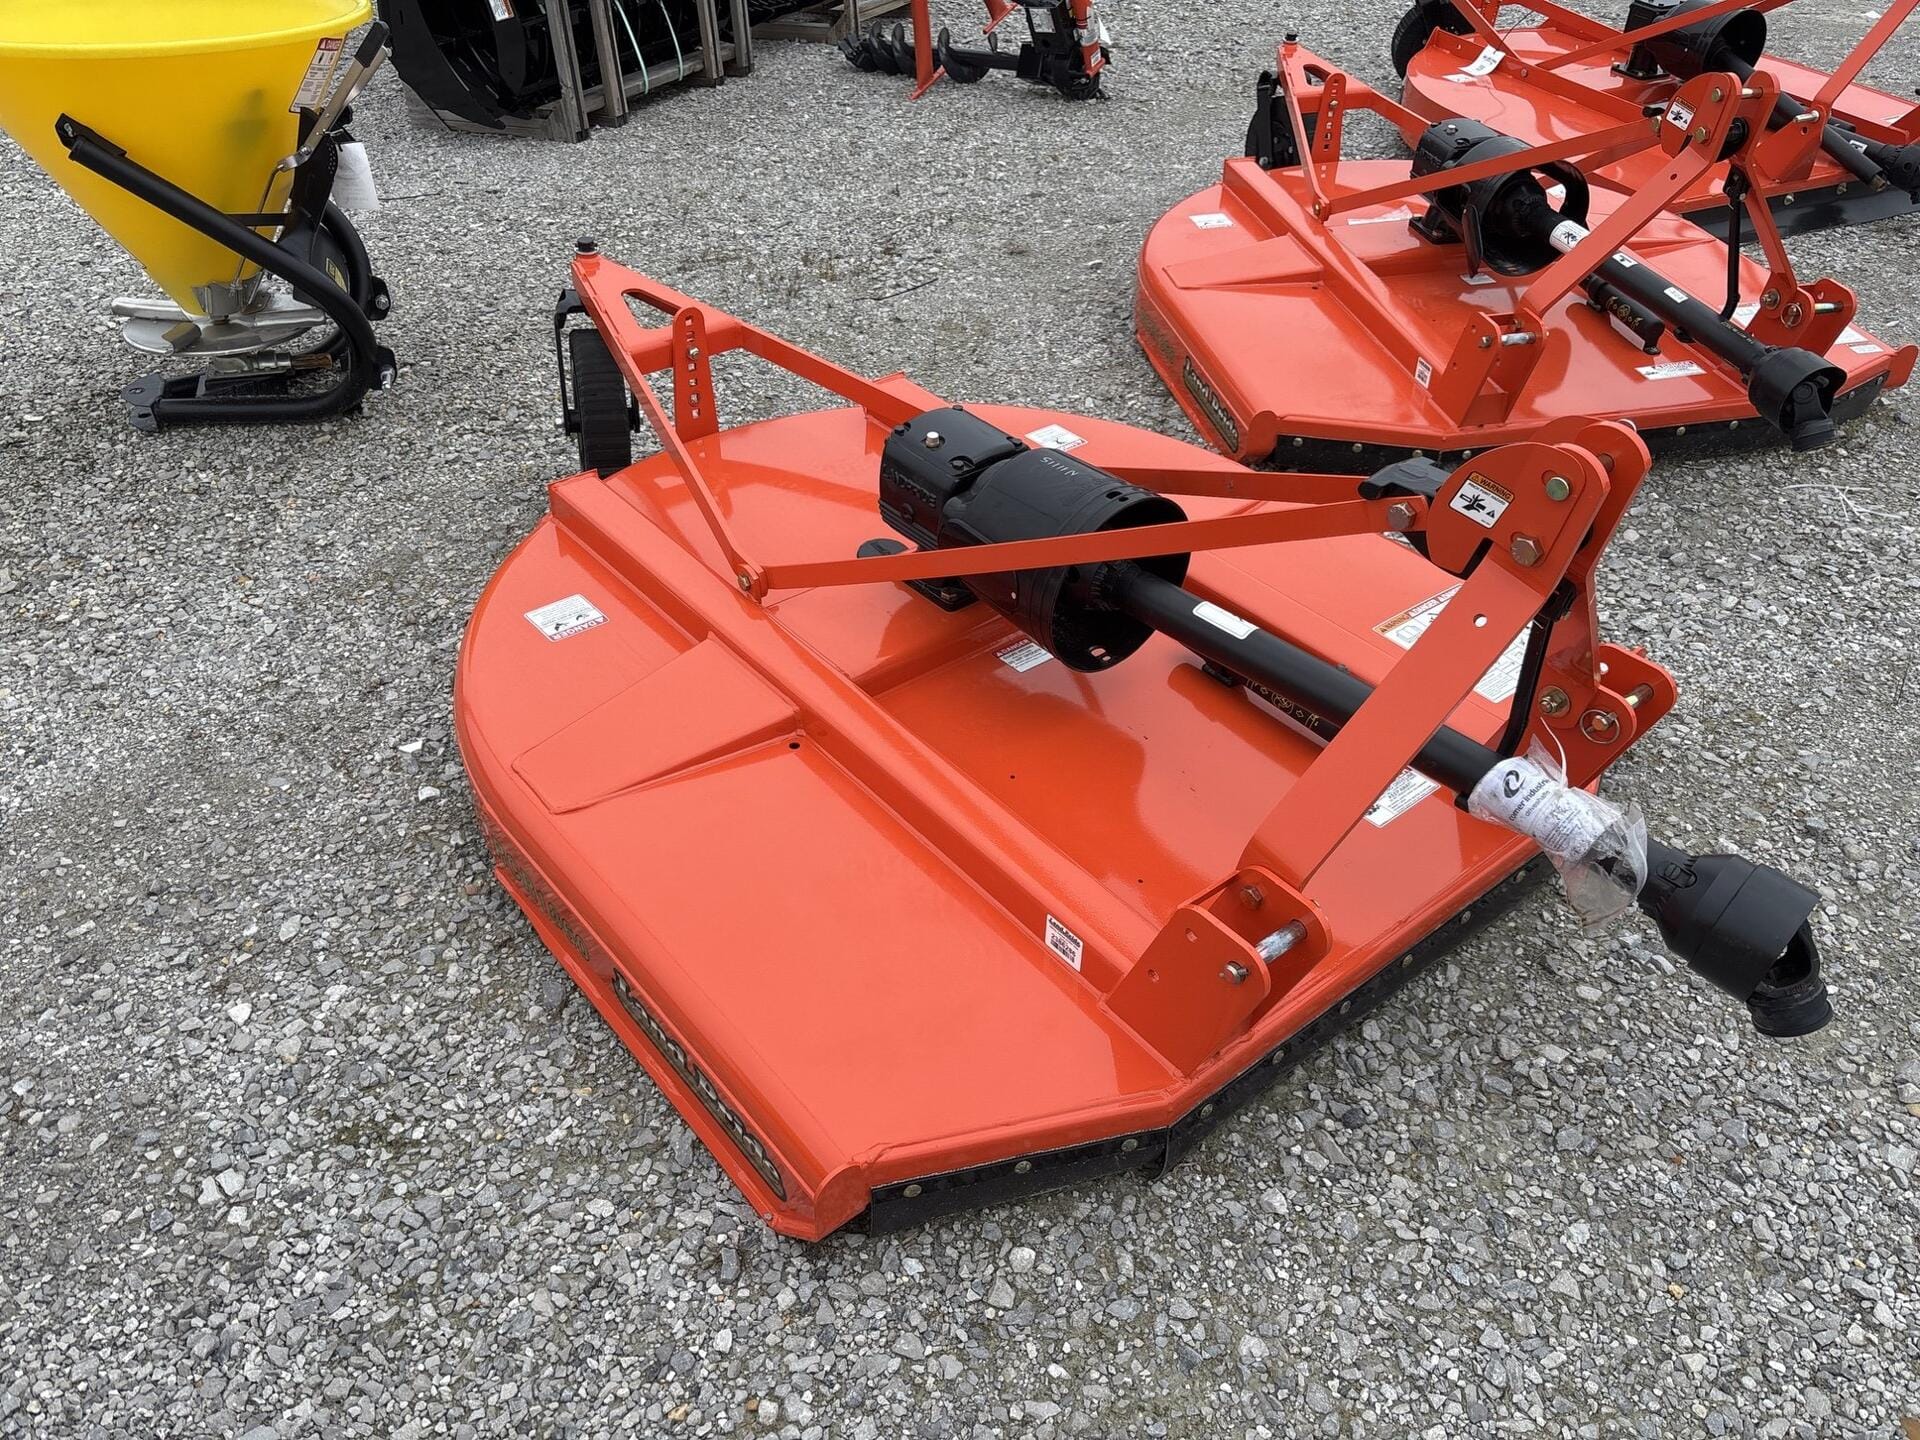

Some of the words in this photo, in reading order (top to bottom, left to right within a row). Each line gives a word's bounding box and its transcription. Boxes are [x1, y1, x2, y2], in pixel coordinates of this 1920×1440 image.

[1480, 477, 1511, 500] WARNING
[552, 619, 598, 640] DANGER
[1001, 638, 1031, 654] DANGER
[613, 967, 690, 1071] Land
[693, 1063, 784, 1185] Pride
